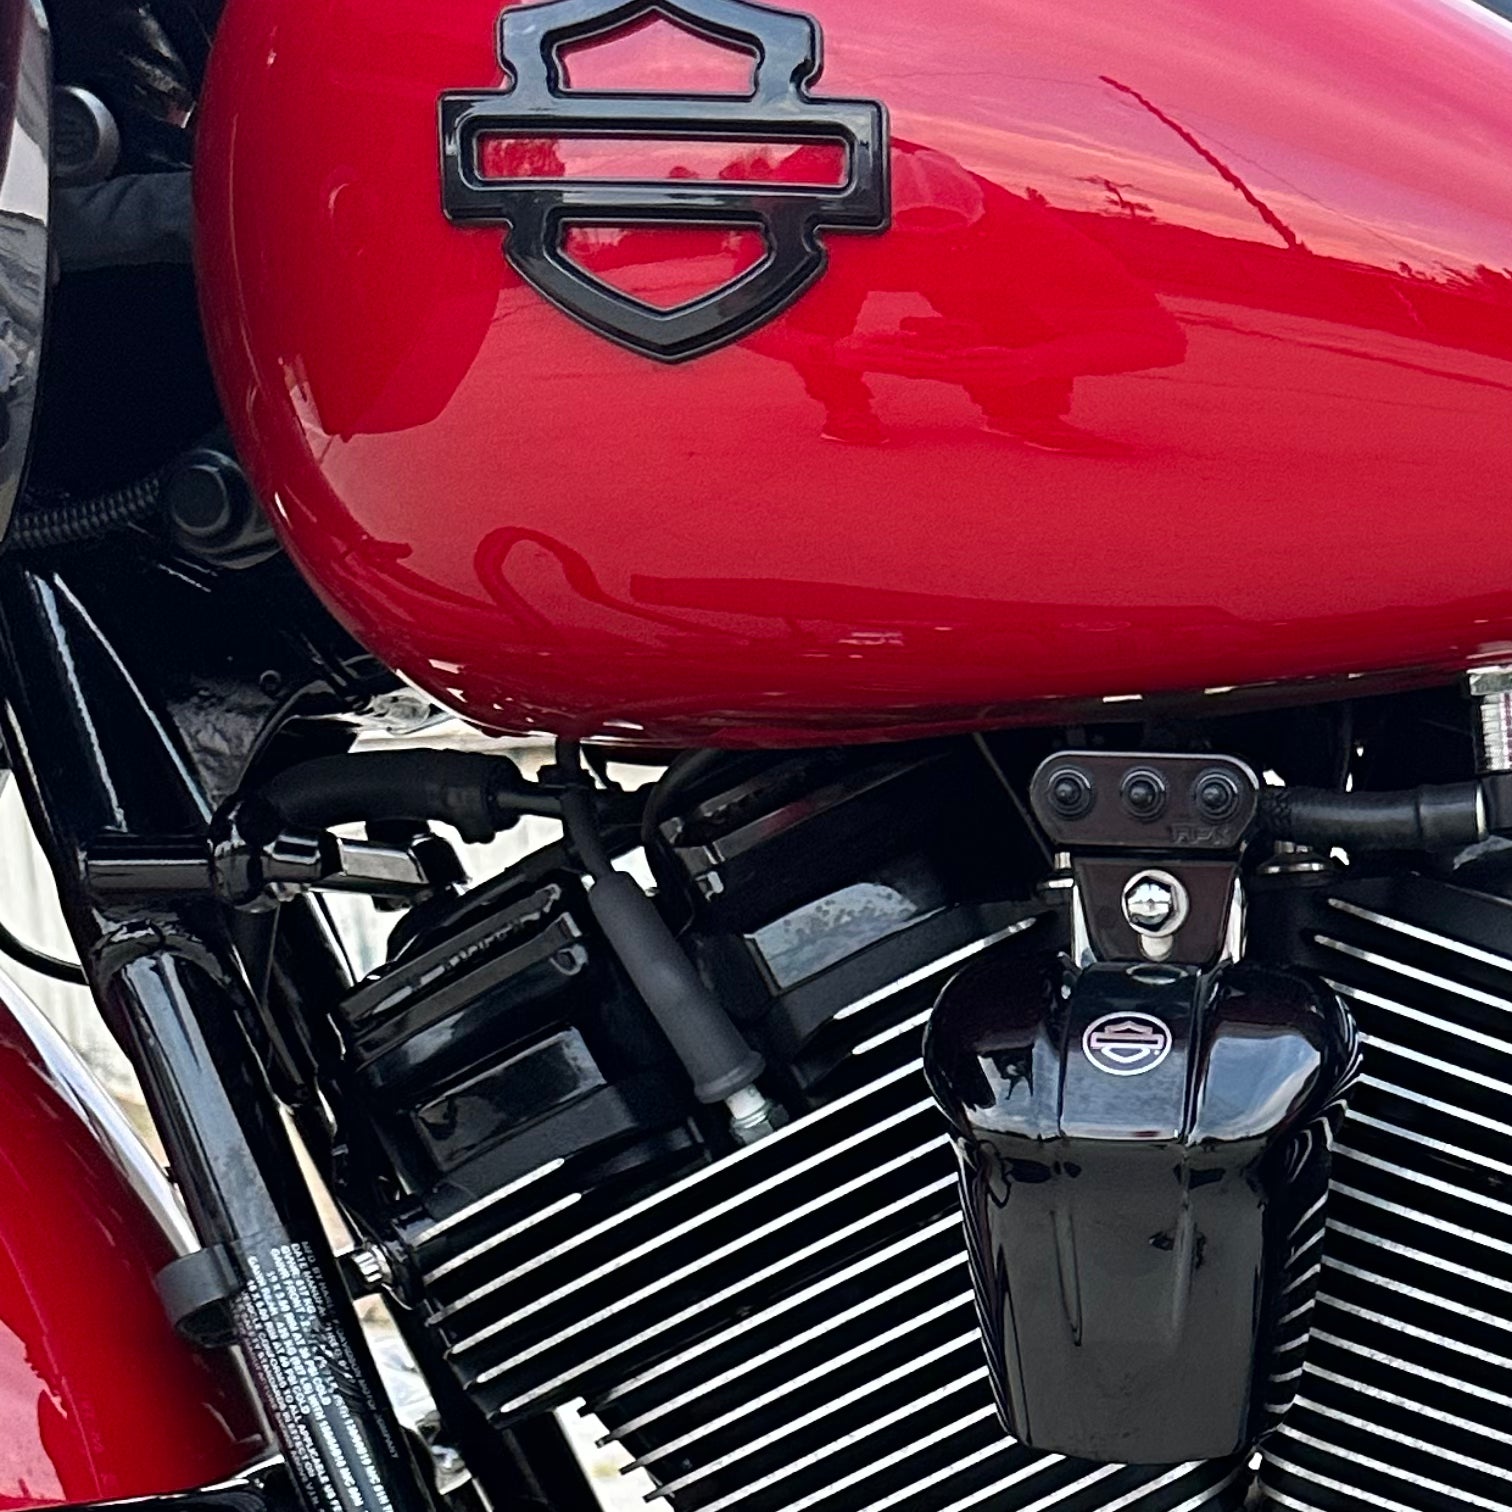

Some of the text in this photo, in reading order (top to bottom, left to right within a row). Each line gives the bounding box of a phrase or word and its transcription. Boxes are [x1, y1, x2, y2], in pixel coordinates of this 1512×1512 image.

[281, 1387, 295, 1404] TO
[287, 1402, 303, 1423] ALL
[296, 1422, 330, 1485] APPLICABLE
